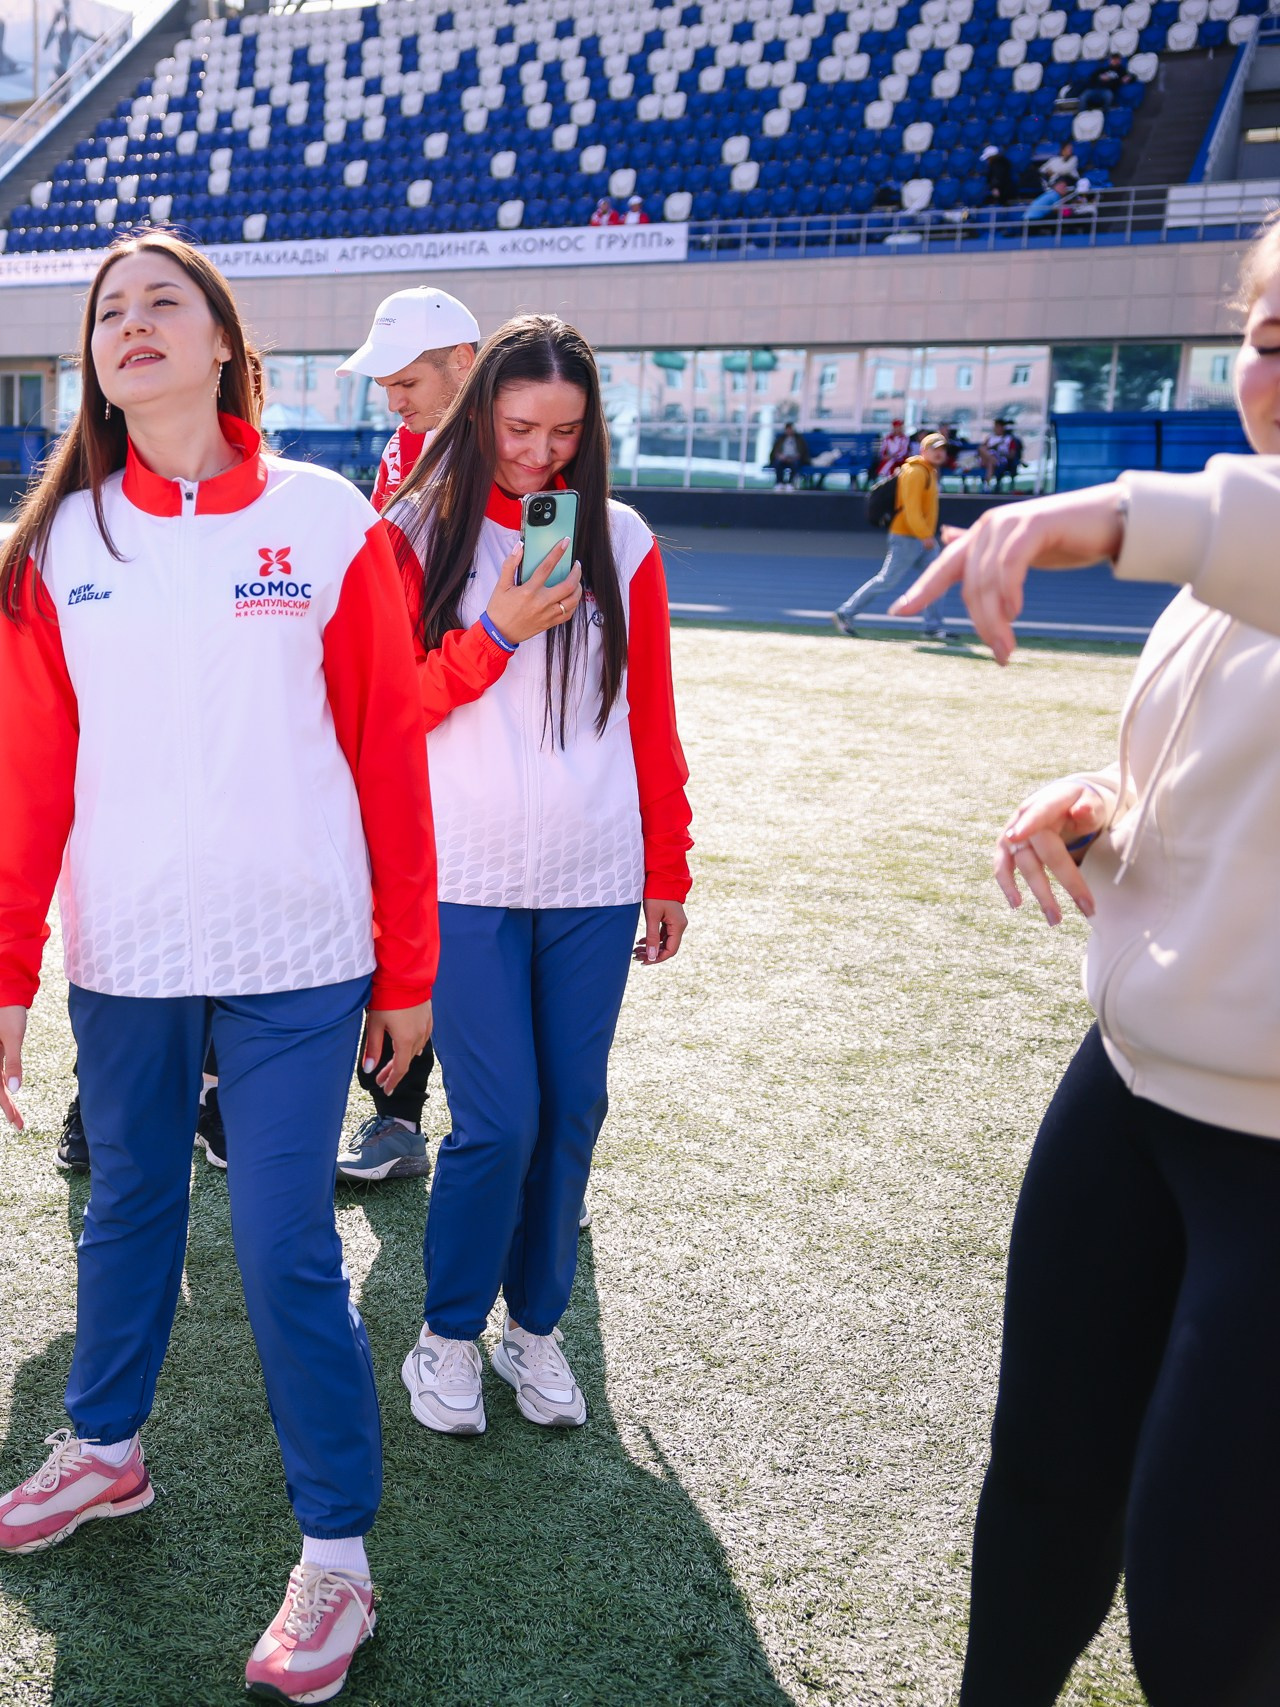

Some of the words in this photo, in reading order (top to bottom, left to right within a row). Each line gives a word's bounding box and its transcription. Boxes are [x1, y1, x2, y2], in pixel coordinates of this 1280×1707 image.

[209, 248, 328, 267] ПАРТАКИАДЫ
[338, 239, 489, 259] АГРОХОЛДИНГА
[500, 234, 585, 253] «КОМОС
[595, 231, 675, 250] ГРУПП»
[69, 583, 95, 597] NEW
[234, 580, 313, 600] КОМОС
[67, 591, 113, 606] LEAGUE
[235, 599, 311, 611] САРАПУЛЬСКИЙ
